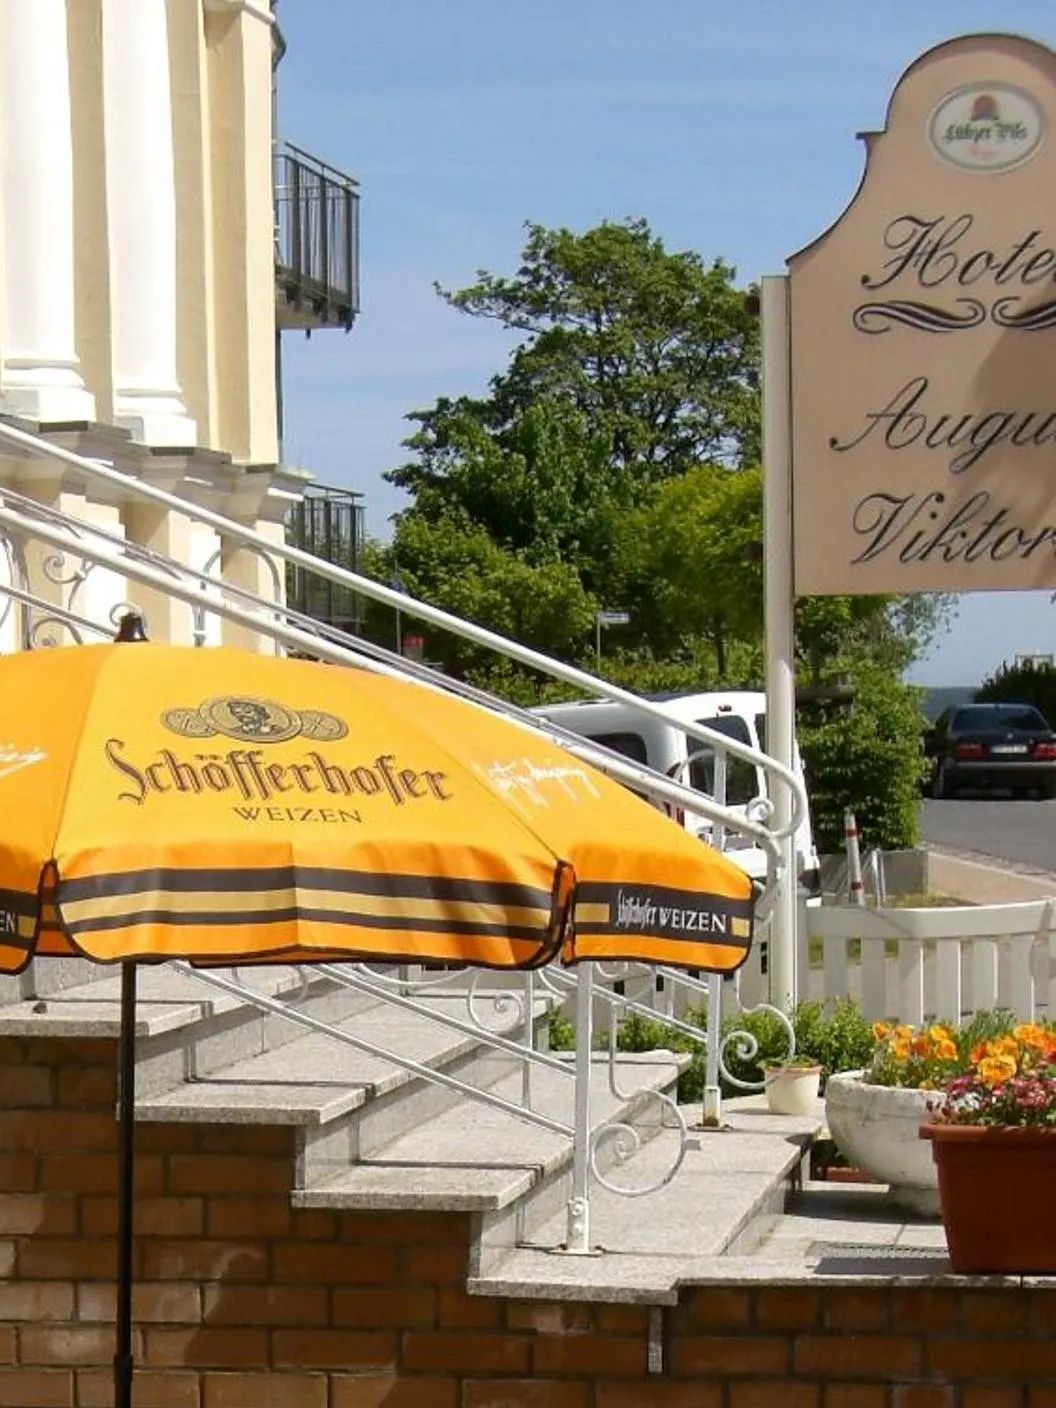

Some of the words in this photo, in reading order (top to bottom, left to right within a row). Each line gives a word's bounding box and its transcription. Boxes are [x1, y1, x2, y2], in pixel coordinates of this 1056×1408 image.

[861, 213, 1056, 290] Hote
[105, 738, 455, 806] Schöfferhofer
[231, 806, 363, 824] WEIZEN
[659, 906, 727, 934] WEIZEN
